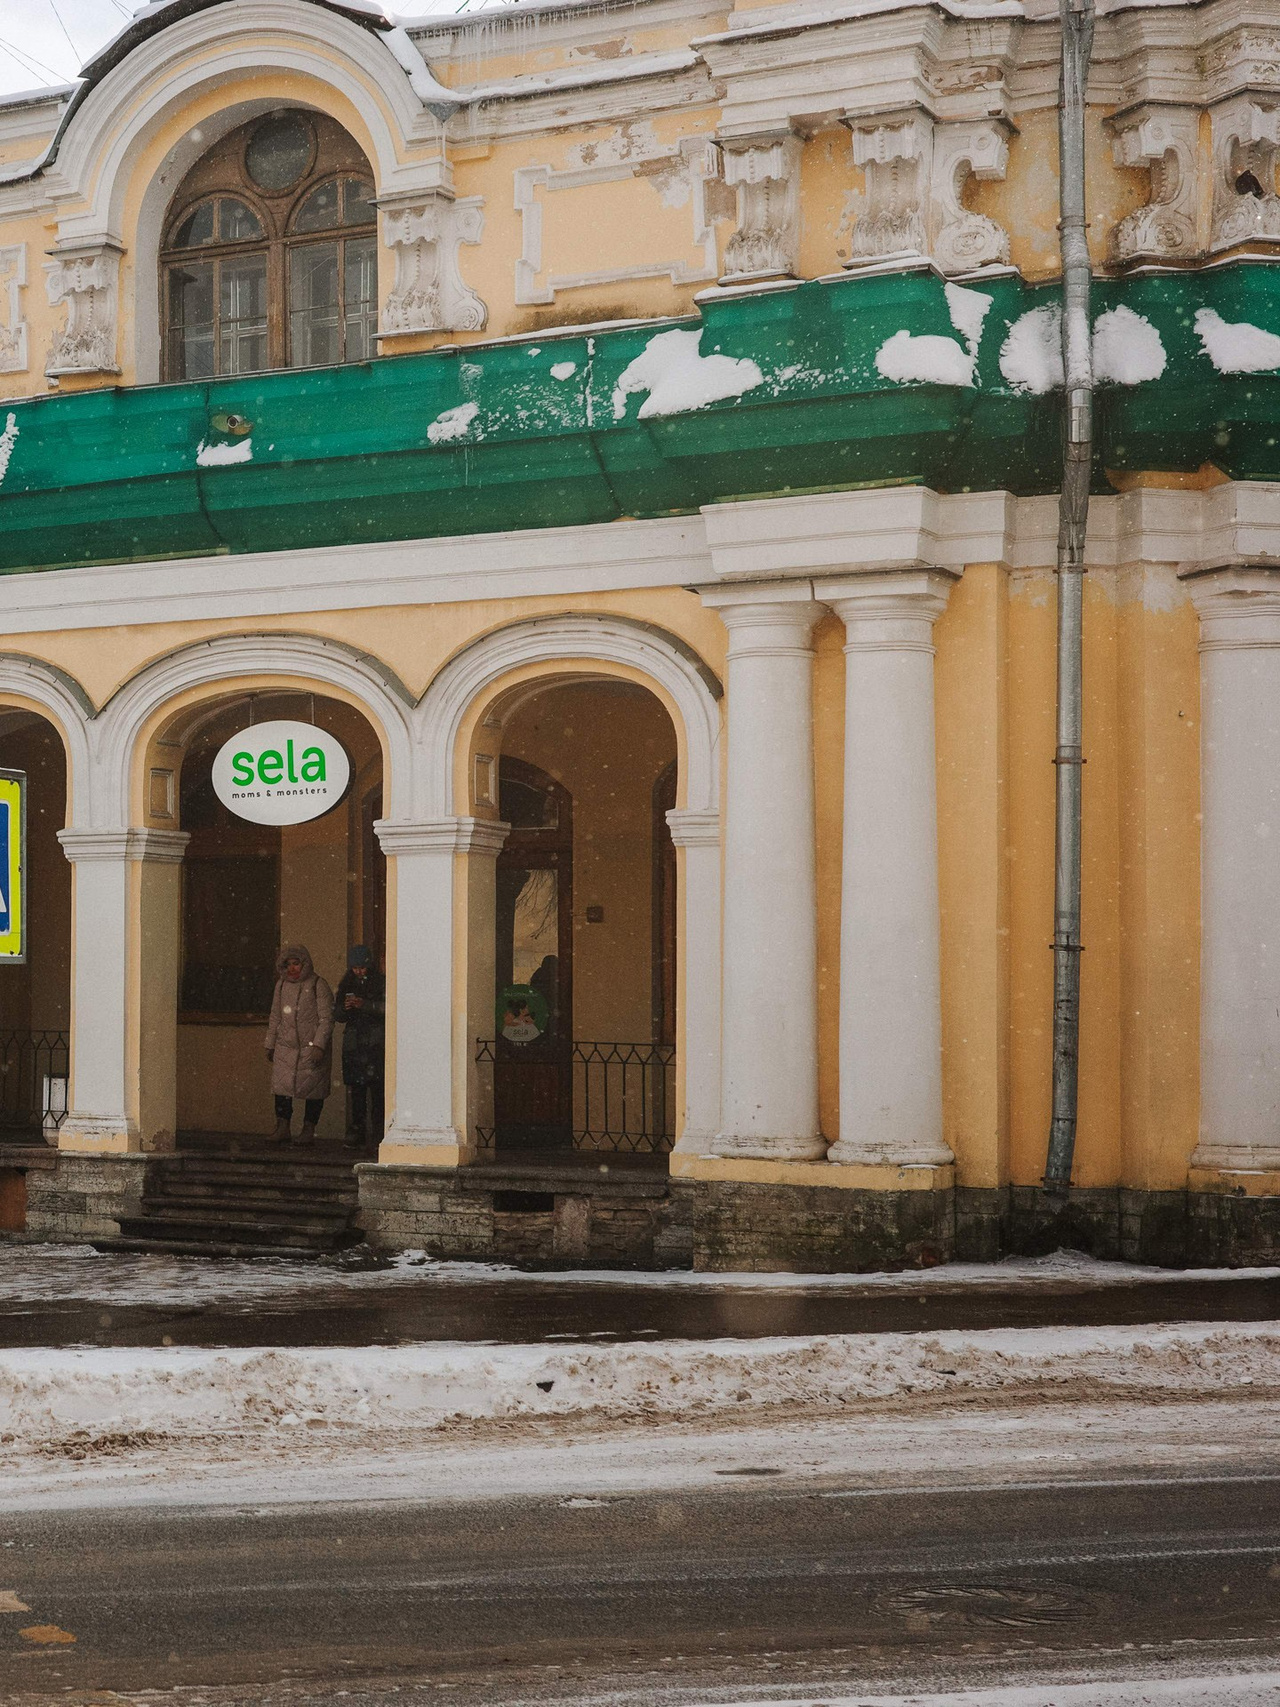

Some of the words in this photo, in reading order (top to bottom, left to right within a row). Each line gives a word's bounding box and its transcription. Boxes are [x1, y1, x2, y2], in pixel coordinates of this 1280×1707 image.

[232, 739, 326, 786] sela
[232, 791, 261, 799] moms
[266, 789, 271, 797] &
[276, 787, 327, 796] monsters
